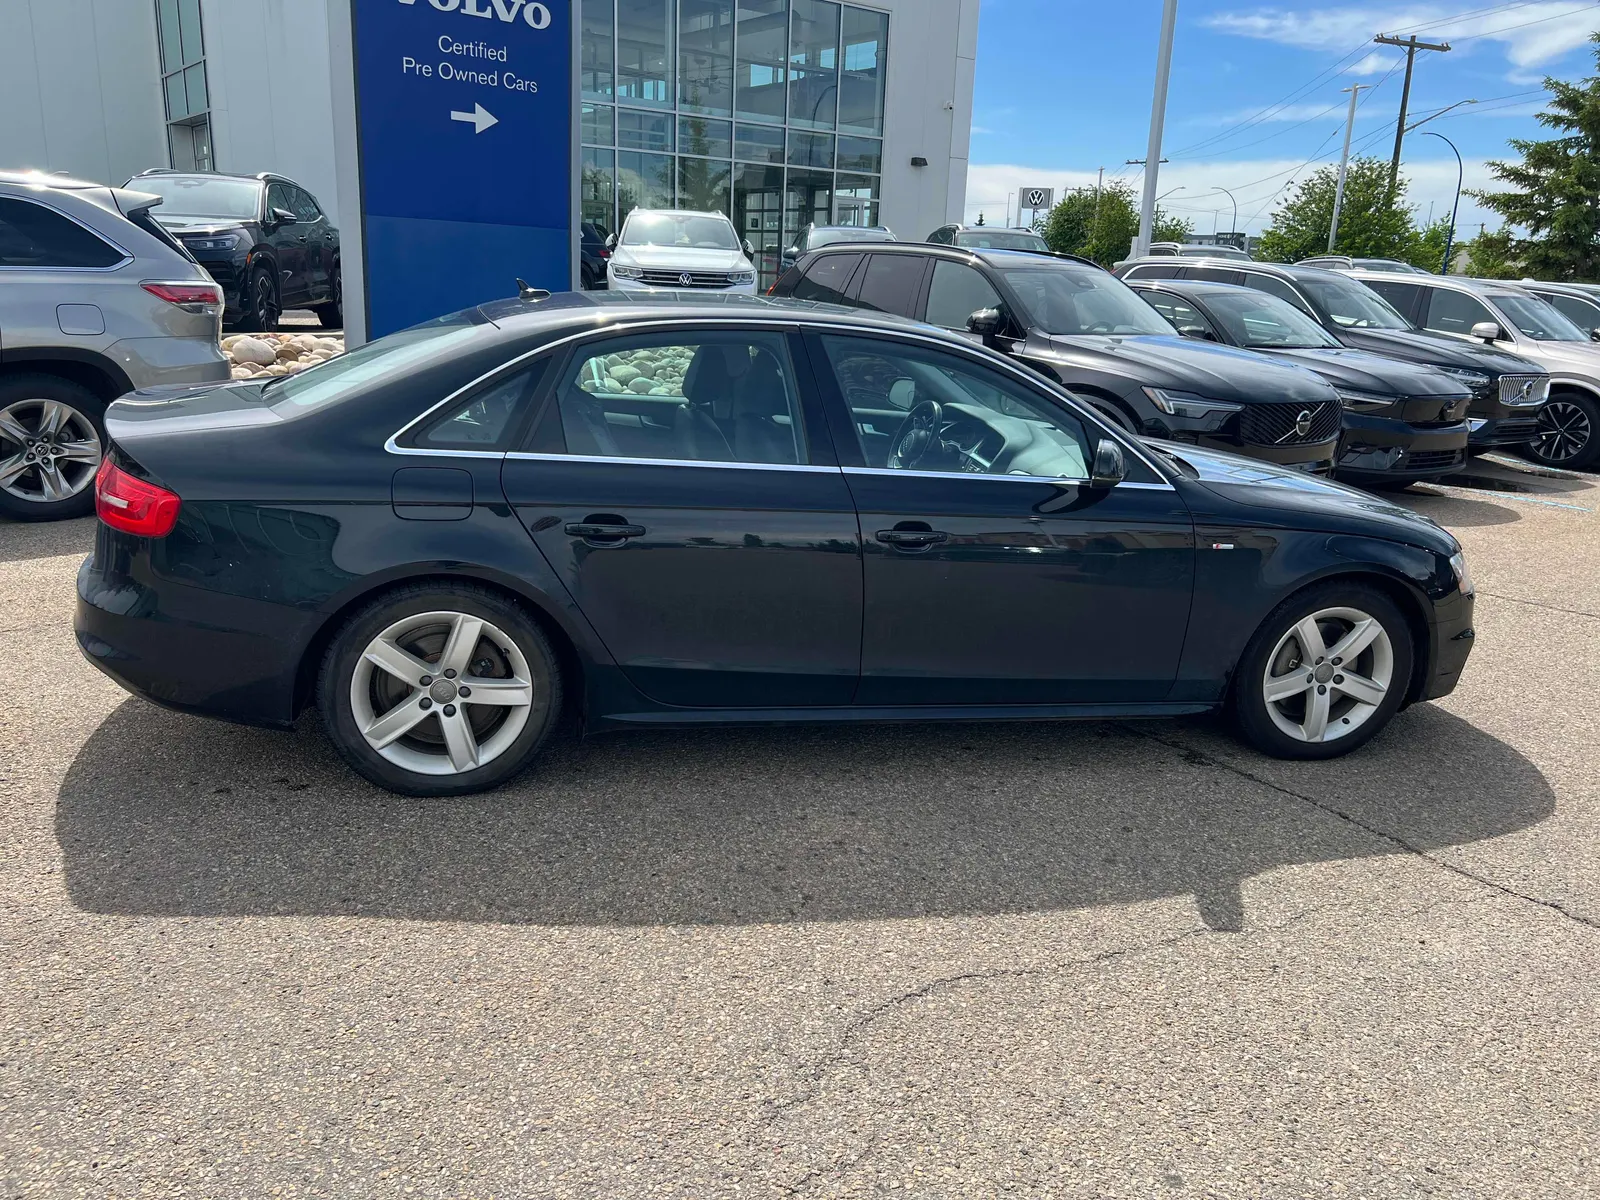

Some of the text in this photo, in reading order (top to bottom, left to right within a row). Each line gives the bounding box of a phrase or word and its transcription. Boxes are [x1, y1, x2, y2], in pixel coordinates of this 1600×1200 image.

[398, 0, 552, 29] LVO
[438, 35, 507, 62] Certified
[402, 57, 538, 93] Pre Owned Cars
